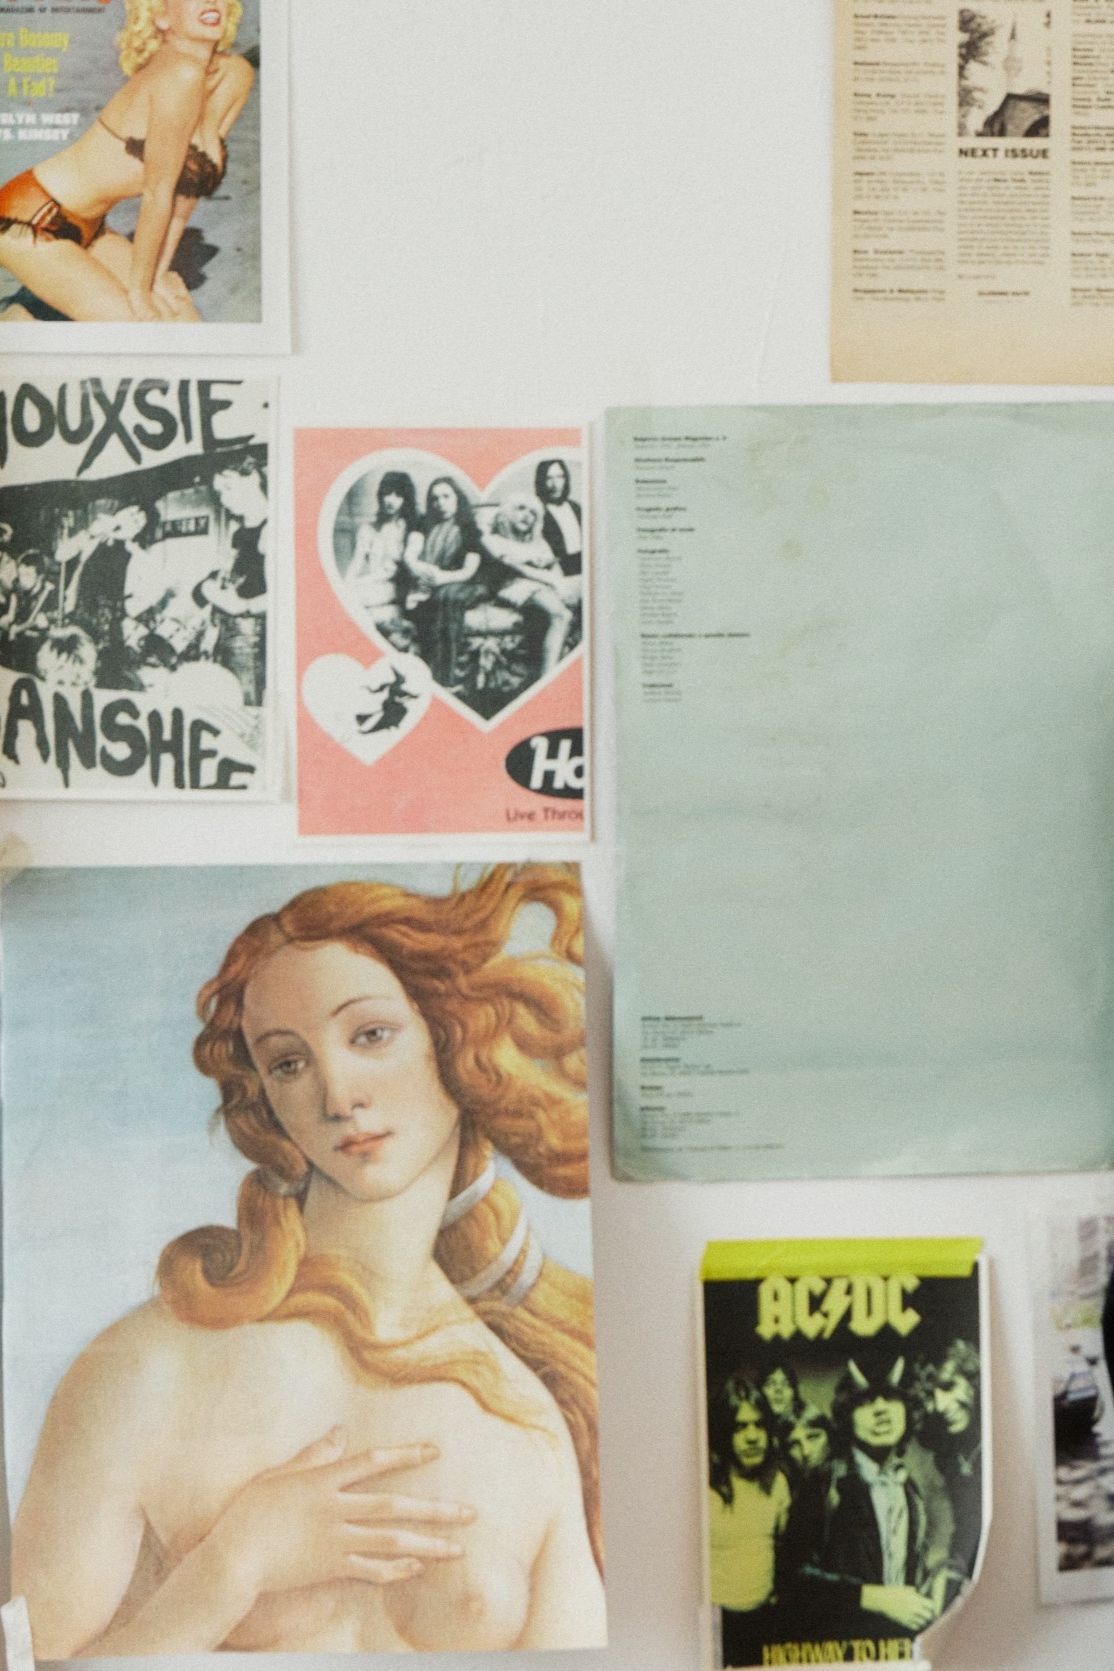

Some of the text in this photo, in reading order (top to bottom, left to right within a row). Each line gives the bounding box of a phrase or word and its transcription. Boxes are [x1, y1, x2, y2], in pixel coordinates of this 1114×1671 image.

[957, 147, 1050, 159] NEXT ISSUE
[505, 806, 536, 823] Live
